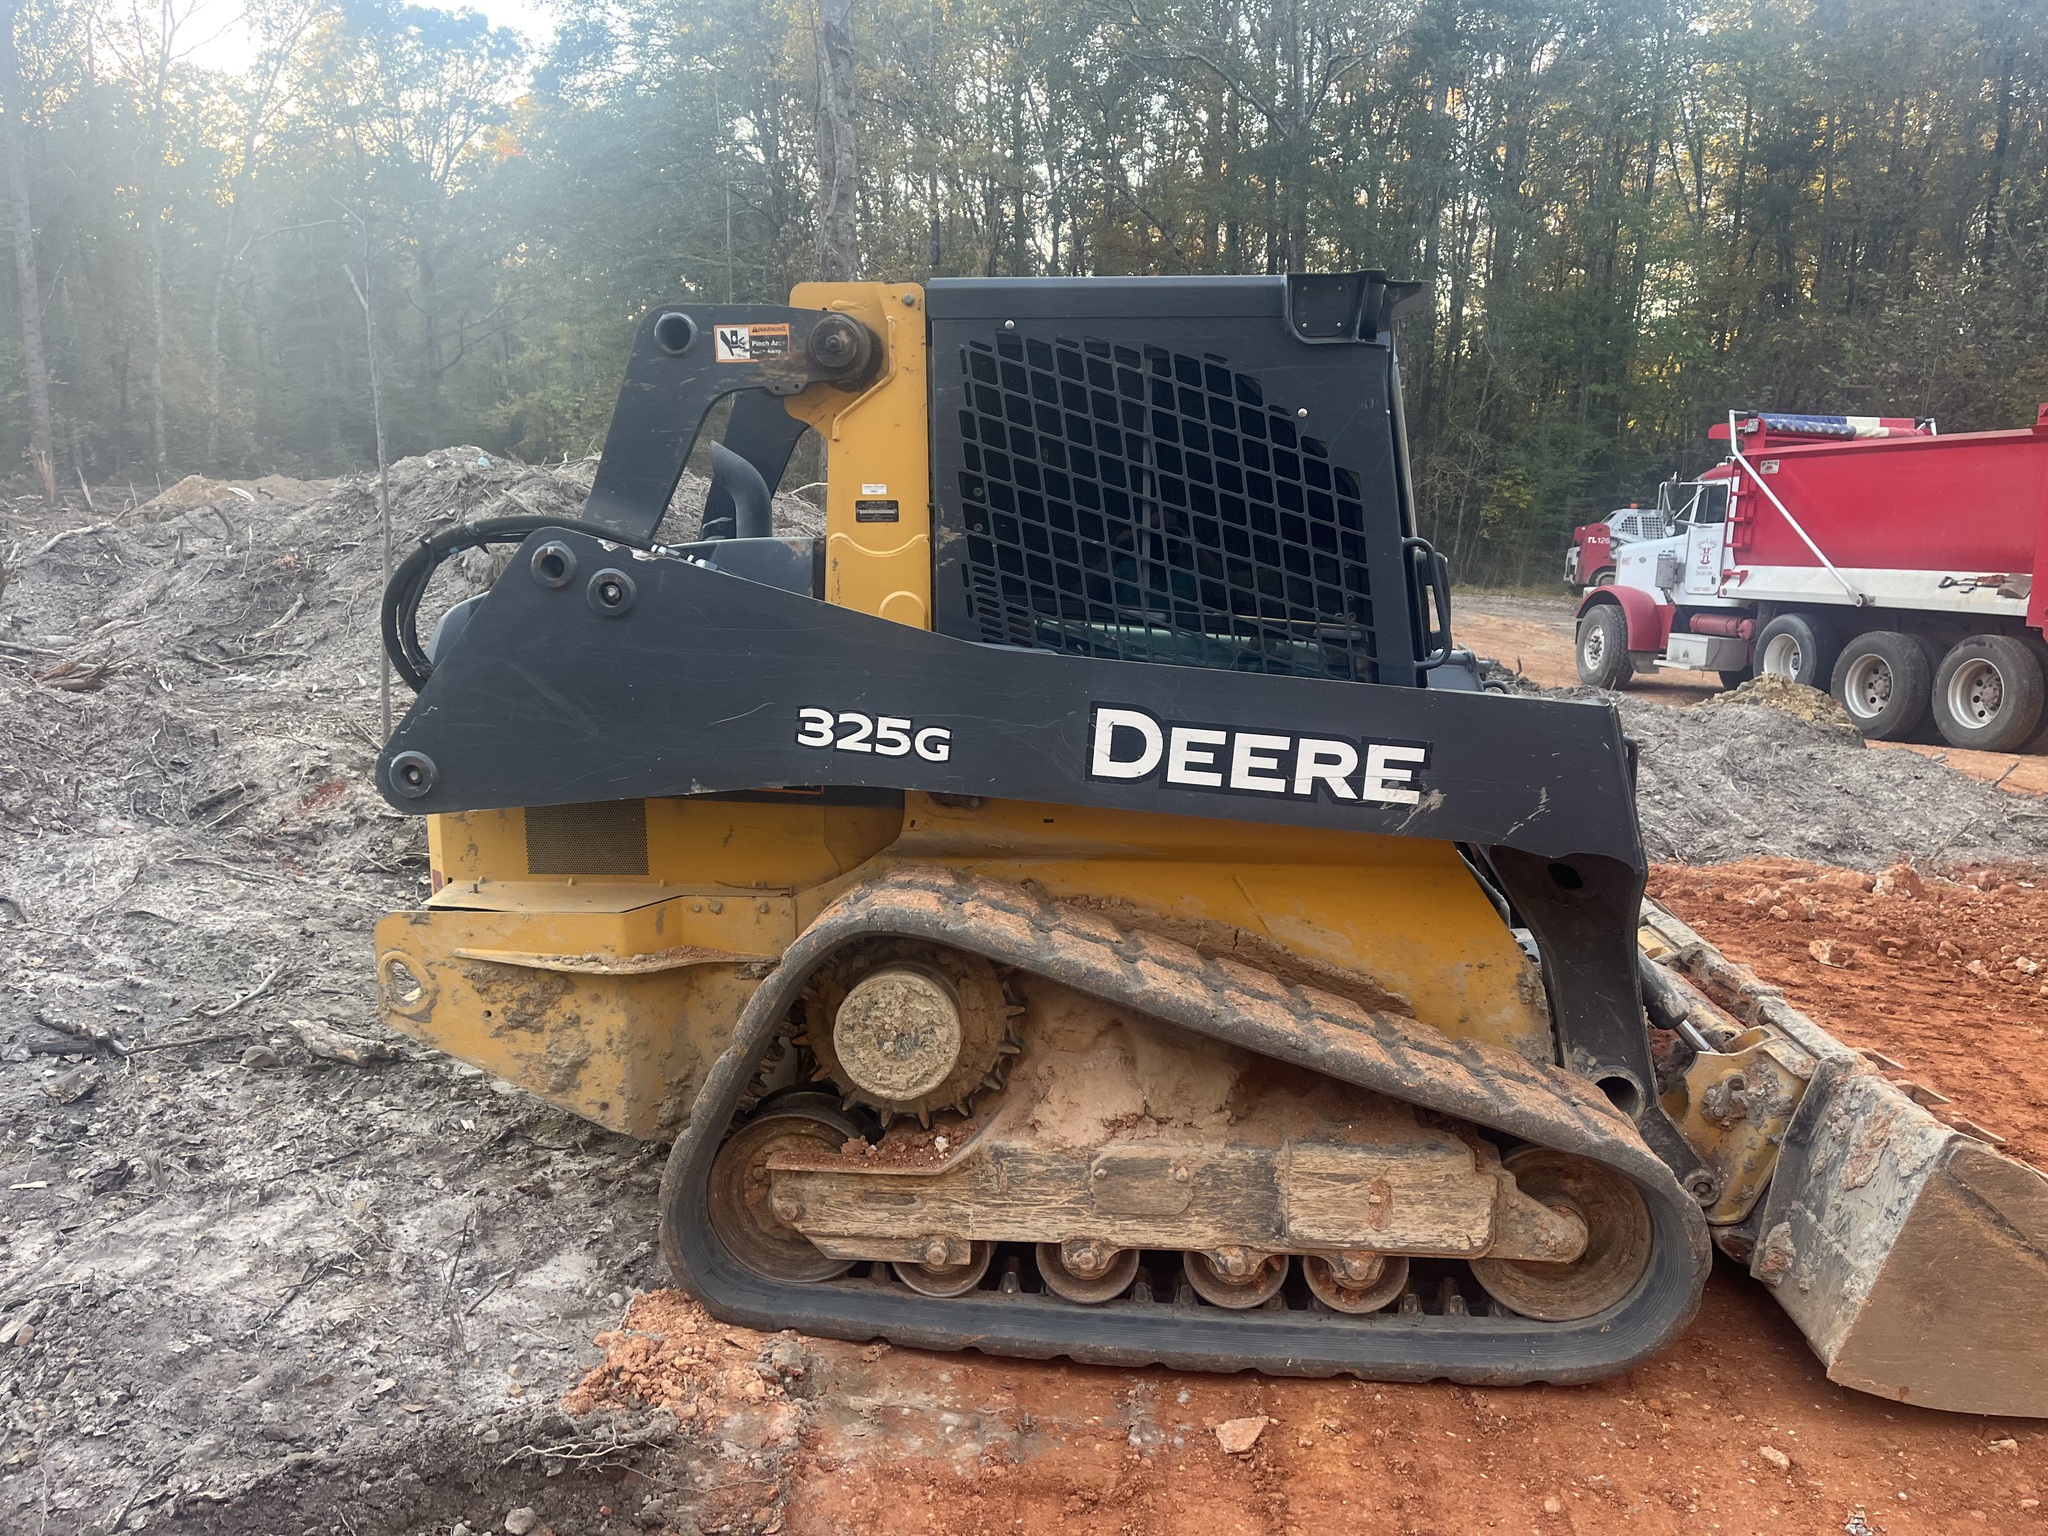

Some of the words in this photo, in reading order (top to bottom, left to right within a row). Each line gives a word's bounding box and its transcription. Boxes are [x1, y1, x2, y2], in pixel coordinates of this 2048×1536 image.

[757, 325, 787, 333] WARNING
[797, 708, 951, 761] 325G
[1091, 708, 1425, 805] DEERE
